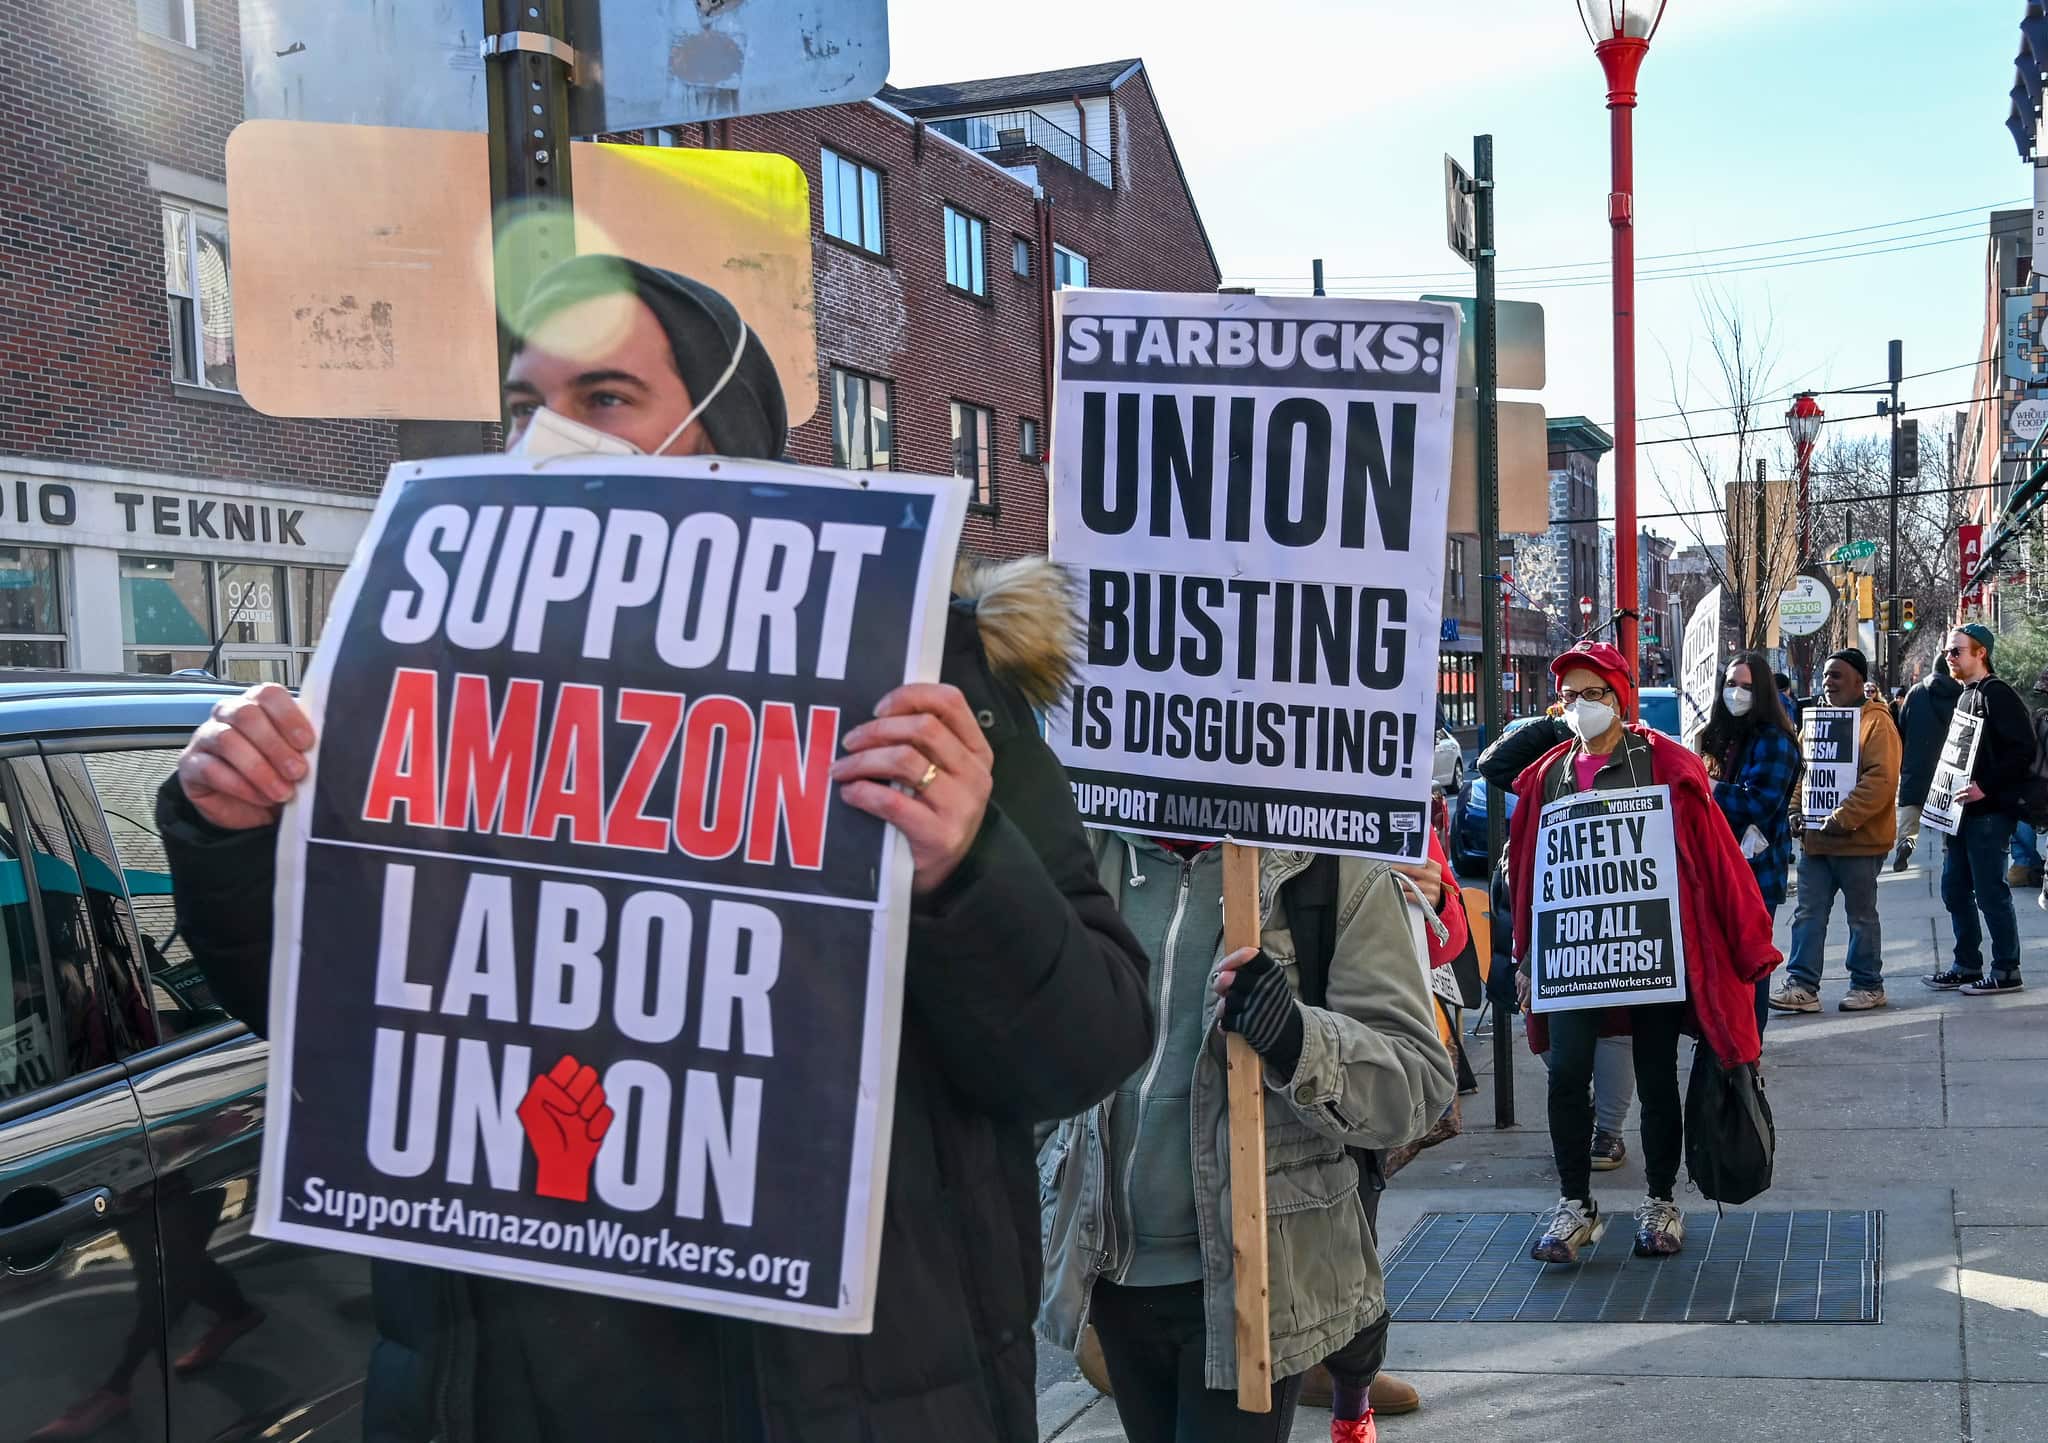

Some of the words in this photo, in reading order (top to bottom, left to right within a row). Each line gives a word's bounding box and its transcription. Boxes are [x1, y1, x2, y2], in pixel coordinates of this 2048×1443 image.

[1067, 316, 1442, 376] STARBUCKS:
[1081, 392, 1417, 552] UNION
[0, 481, 77, 526] IO
[114, 491, 306, 546] TEKNIK
[228, 582, 271, 609] 936
[230, 610, 273, 622] SOUTH
[381, 503, 886, 680] SUPPORT
[1780, 602, 1821, 613] 924308
[1087, 569, 1408, 690] BUSTING
[1072, 685, 1113, 749] IS
[1124, 689, 1417, 779] DISGUSTING!
[361, 667, 841, 871] AMAZON
[1164, 794, 1259, 833] AMAZON
[1265, 803, 1380, 845] WORKERS
[1547, 808, 1571, 825] SUPPORT
[1608, 799, 1653, 814] WORKERS
[1802, 791, 1840, 810] STING!
[1547, 816, 1646, 866] SAFETY
[1543, 871, 1556, 903] &
[1560, 858, 1658, 900] UNIONS
[1556, 909, 1594, 944] FOR
[1598, 905, 1642, 939] ALL
[374, 863, 783, 1058] LABOR
[1545, 938, 1663, 980] WORKERS!
[1540, 976, 1672, 996] SupportAmazonWorkers.org
[366, 1027, 764, 1227] UNON
[302, 1176, 811, 1298] SupportAmazonWorkers.org
